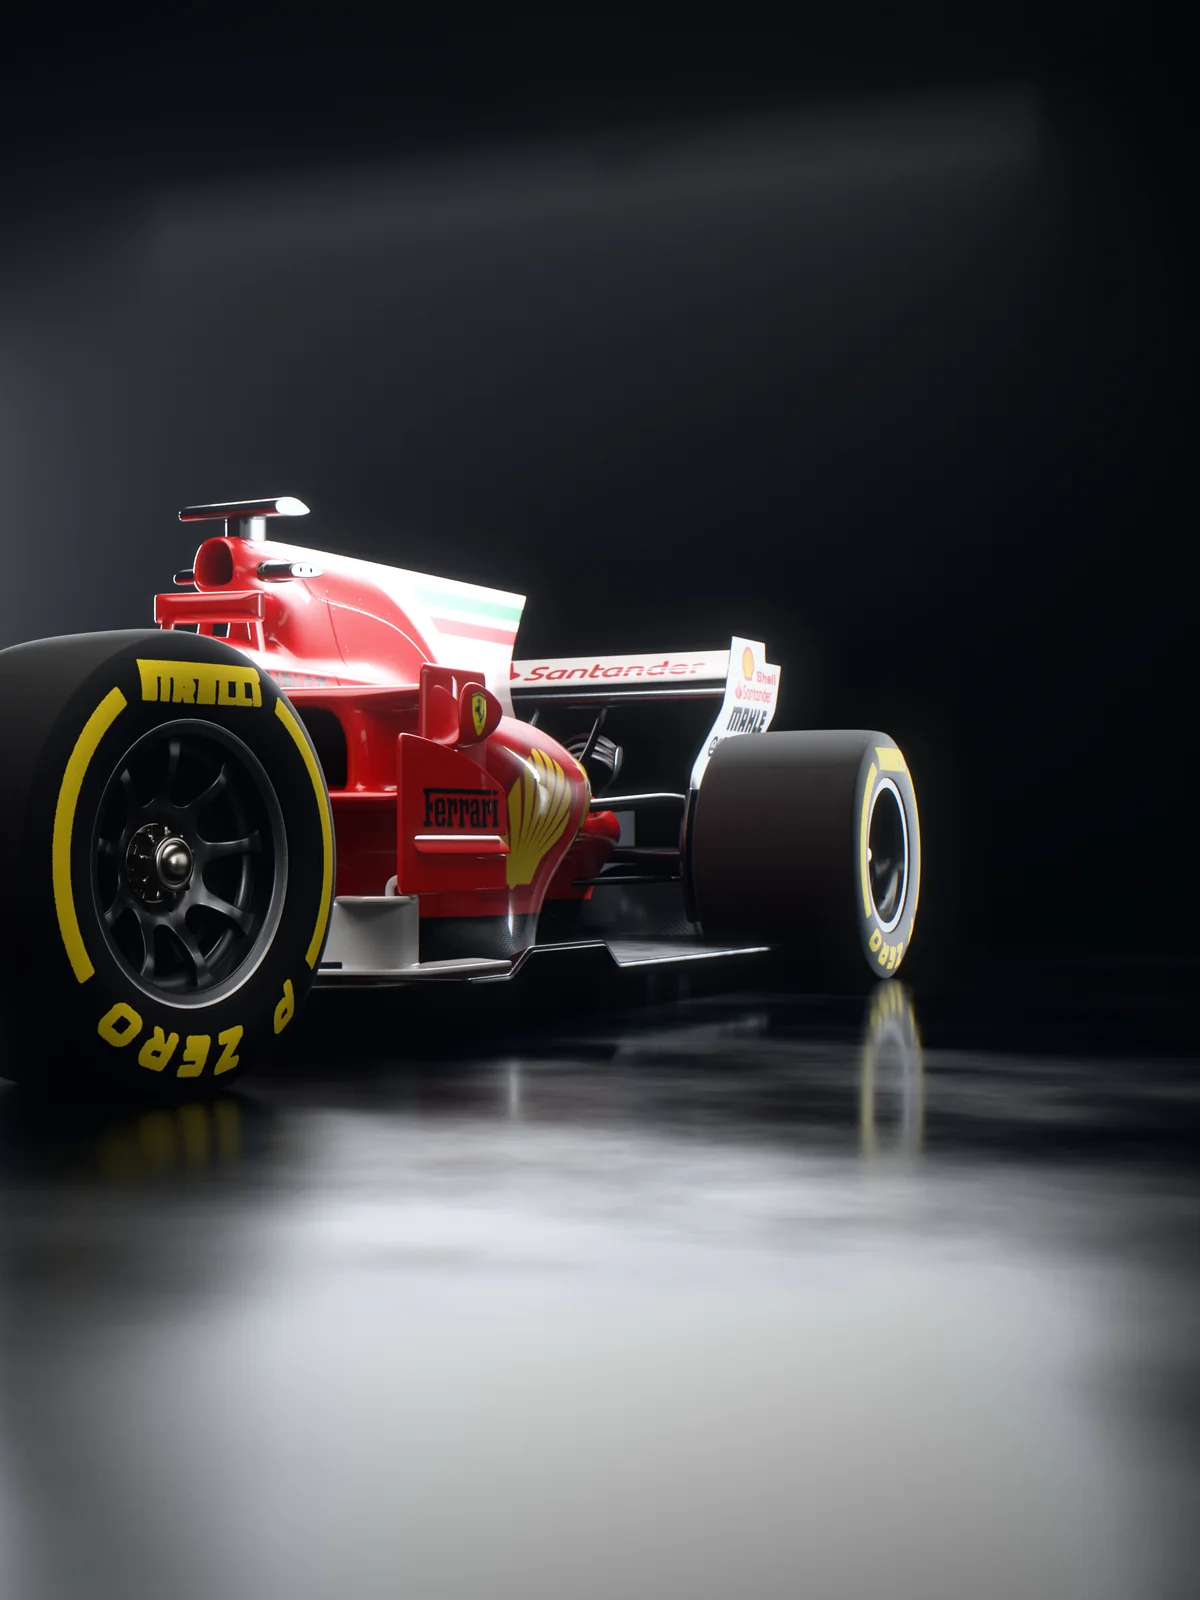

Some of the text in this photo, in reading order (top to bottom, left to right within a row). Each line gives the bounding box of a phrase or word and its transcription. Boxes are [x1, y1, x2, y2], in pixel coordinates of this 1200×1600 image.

[524, 660, 706, 681] Santander
[756, 670, 776, 685] Shell
[743, 684, 772, 703] Santander
[726, 706, 767, 733] MAHLE
[423, 788, 499, 828] Ferrari
[97, 979, 295, 1078] P ZERO
